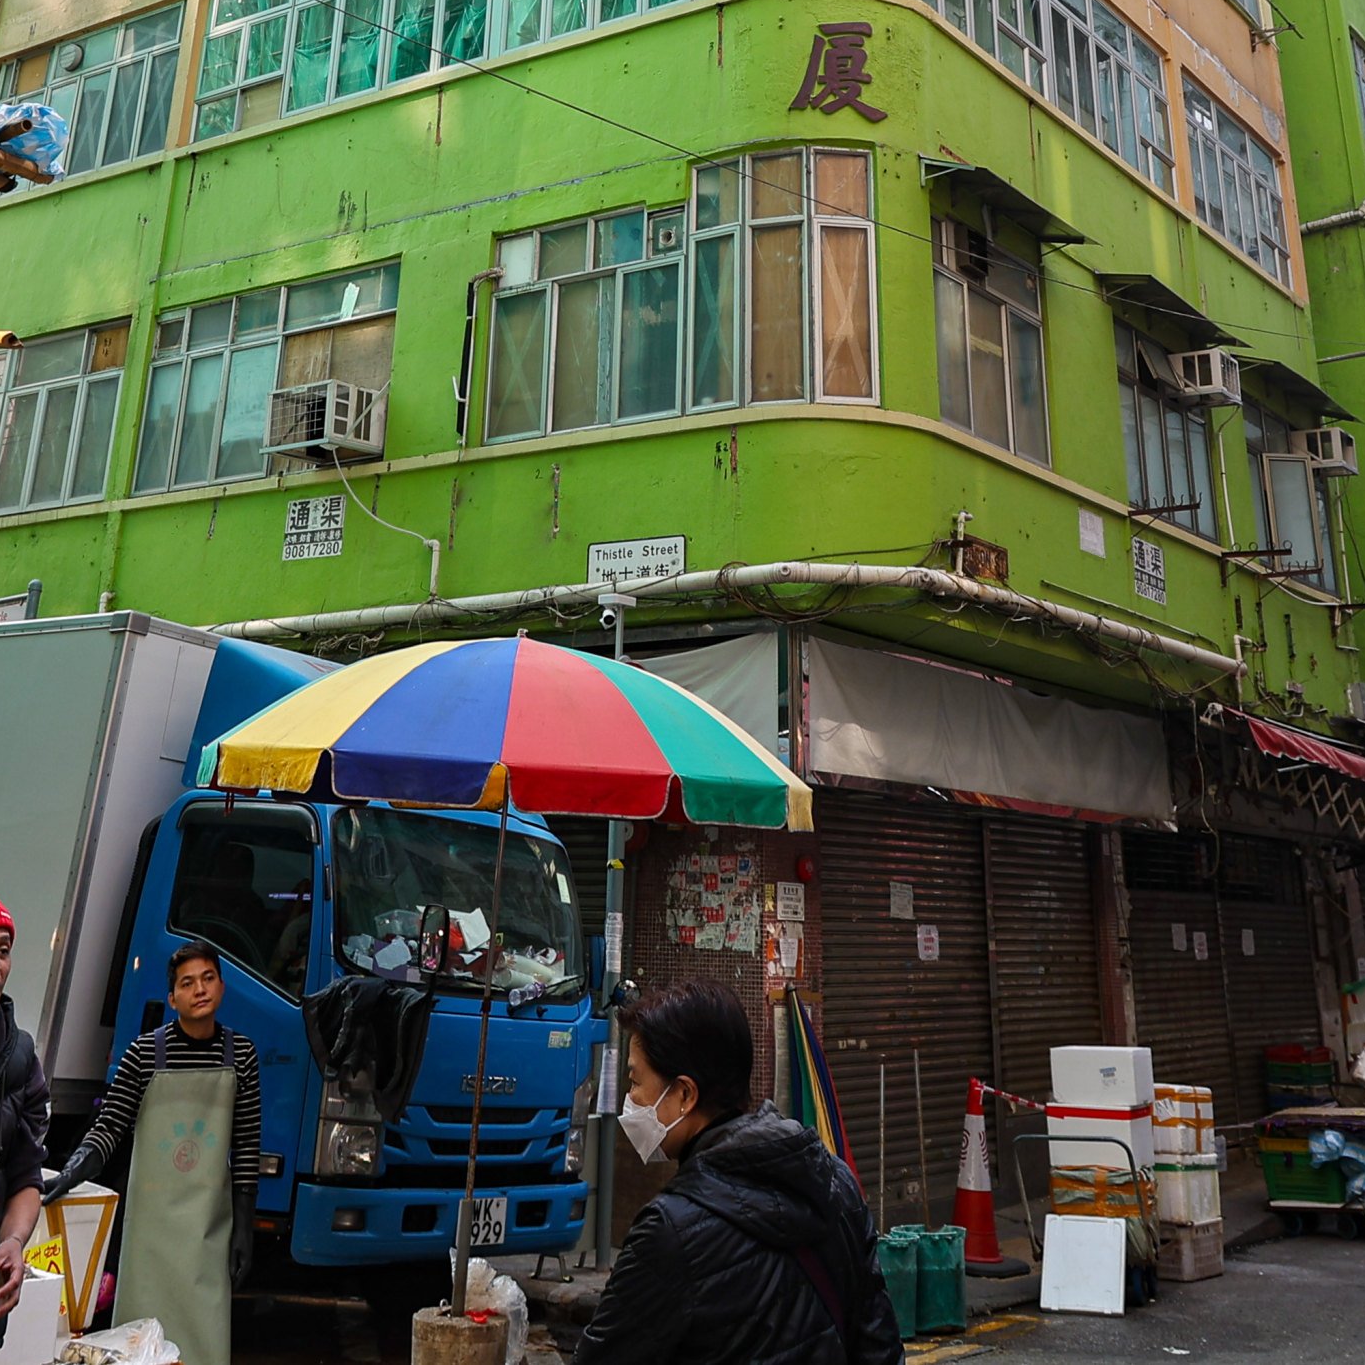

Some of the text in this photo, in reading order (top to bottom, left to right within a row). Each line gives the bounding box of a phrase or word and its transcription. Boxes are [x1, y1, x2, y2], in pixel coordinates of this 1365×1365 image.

[284, 541, 340, 559] 90817280
[595, 543, 679, 561] Thistle Street
